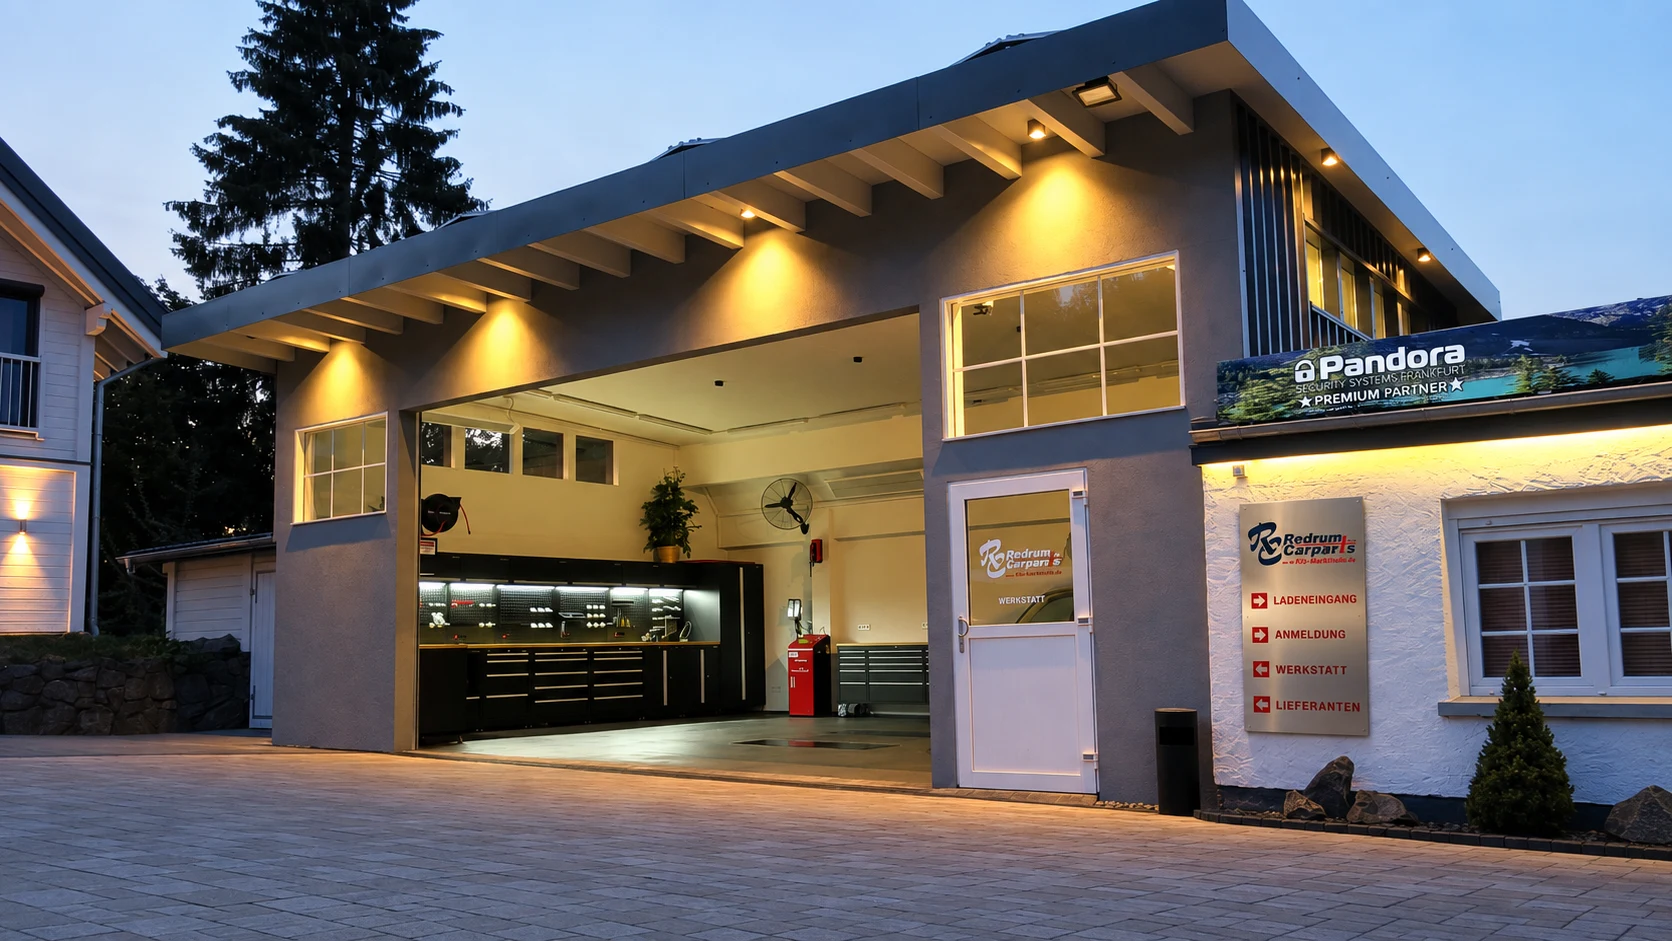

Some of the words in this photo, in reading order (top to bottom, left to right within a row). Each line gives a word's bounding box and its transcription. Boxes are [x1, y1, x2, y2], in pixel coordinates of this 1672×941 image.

[1320, 344, 1466, 380] Pandora
[1296, 380, 1345, 394] SECURITY
[1349, 373, 1398, 388] SYSTEMS
[1401, 364, 1466, 382] FRANKFURT
[1314, 389, 1380, 406] PREMIUM
[1384, 381, 1448, 398] PARTNER
[1283, 533, 1342, 545] Redrum
[1283, 536, 1356, 557] Carparts
[1006, 549, 1051, 560] Redrum
[1006, 552, 1061, 569] Carparts
[998, 595, 1046, 604] WERKSTATT
[1273, 594, 1357, 605] LADENEINGANG
[1275, 629, 1346, 639] ANMELDUNG
[1275, 665, 1347, 675] WERKSTATT
[1276, 700, 1361, 712] LIEFERANTEN
